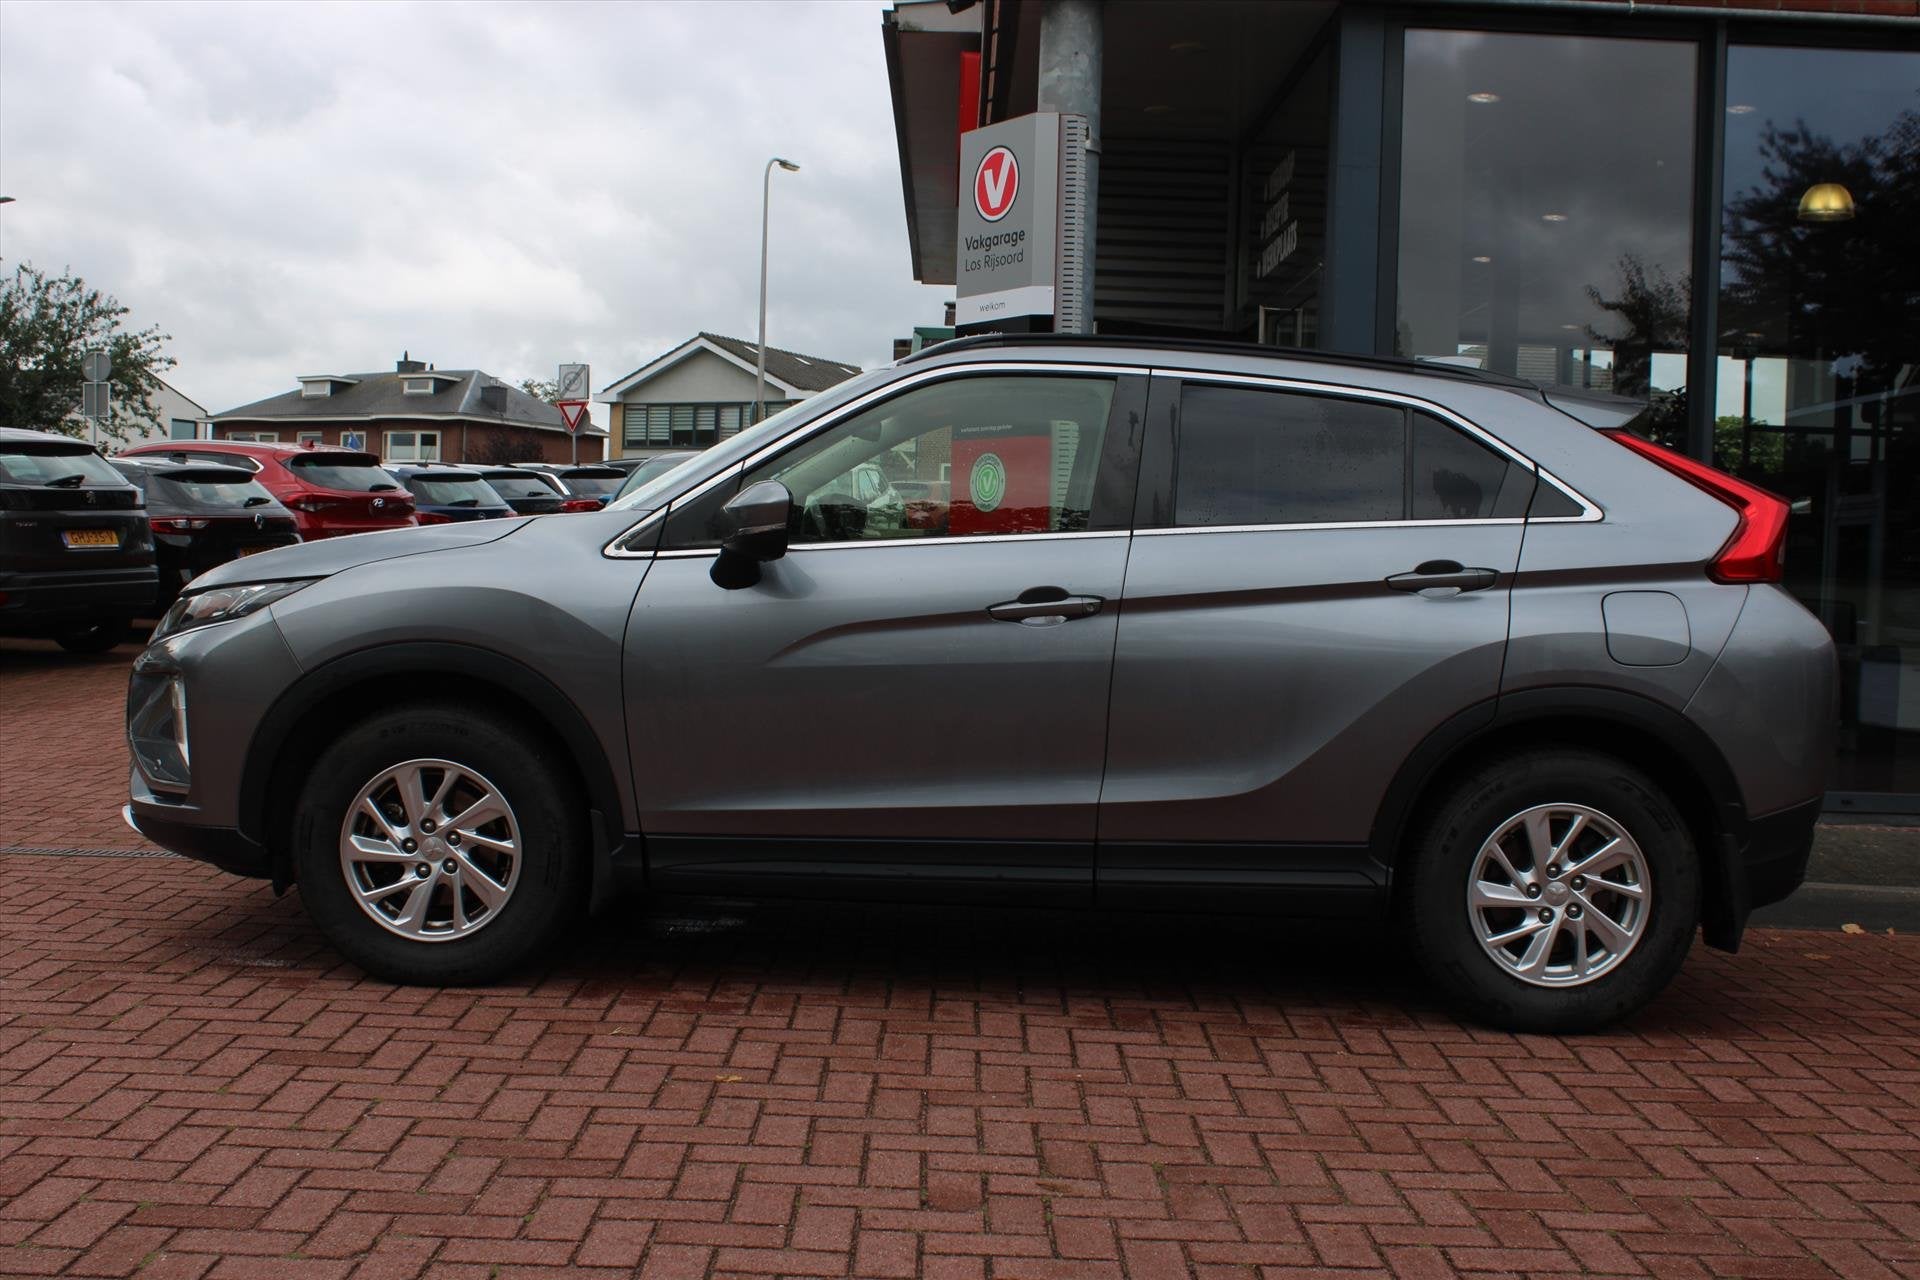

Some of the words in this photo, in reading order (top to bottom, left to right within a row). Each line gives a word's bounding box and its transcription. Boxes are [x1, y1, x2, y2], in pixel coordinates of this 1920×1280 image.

[965, 230, 1025, 252] Vakgarage
[965, 259, 981, 272] Los
[984, 248, 1024, 271] Rijsoord
[979, 301, 1006, 312] welkom
